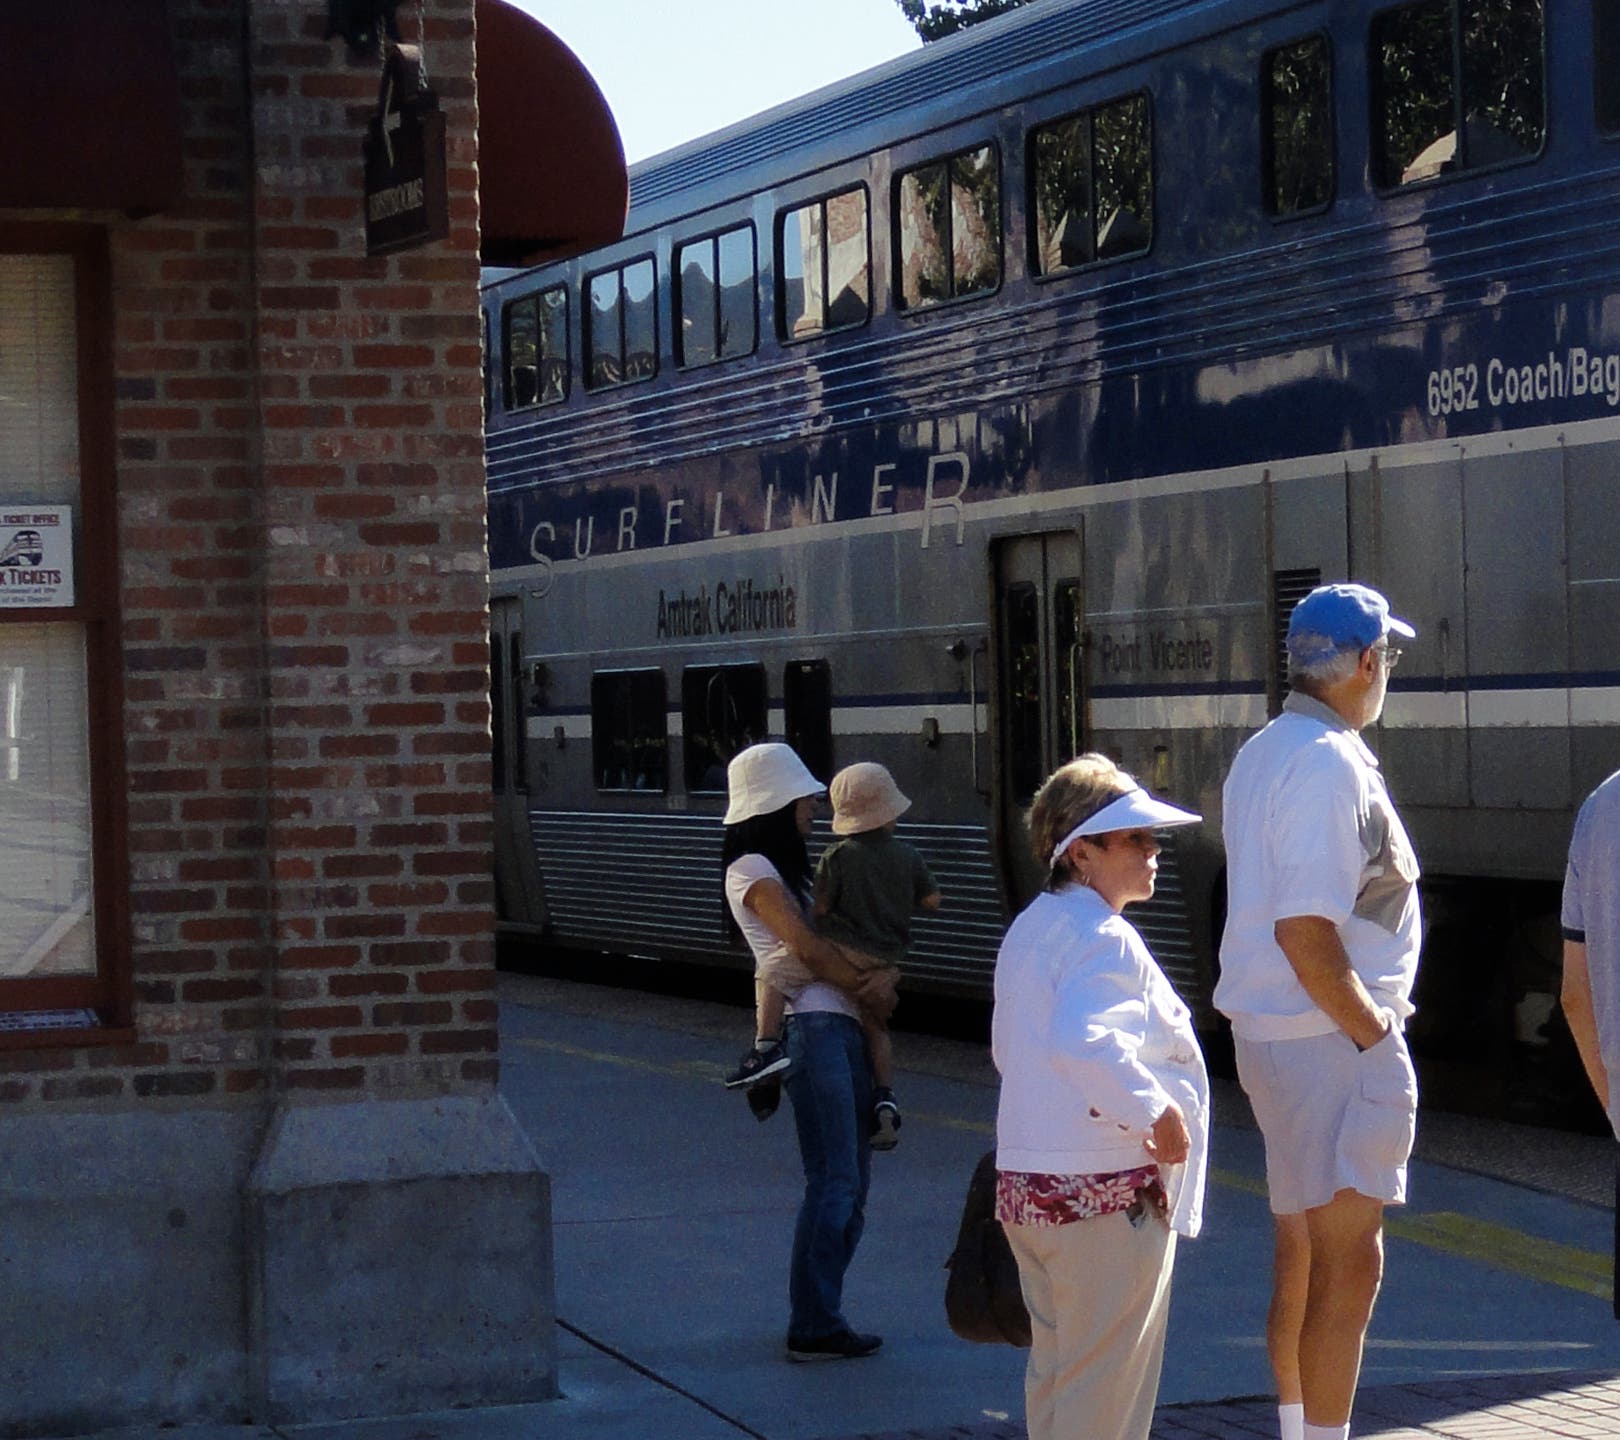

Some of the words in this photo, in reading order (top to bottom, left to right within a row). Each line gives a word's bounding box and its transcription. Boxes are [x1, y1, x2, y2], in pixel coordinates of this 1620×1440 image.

[1427, 363, 1480, 417] 6952
[9, 568, 62, 585] TICKETS
[657, 584, 712, 638] Amtrak
[716, 576, 796, 634] California
[1102, 634, 1141, 673] Point
